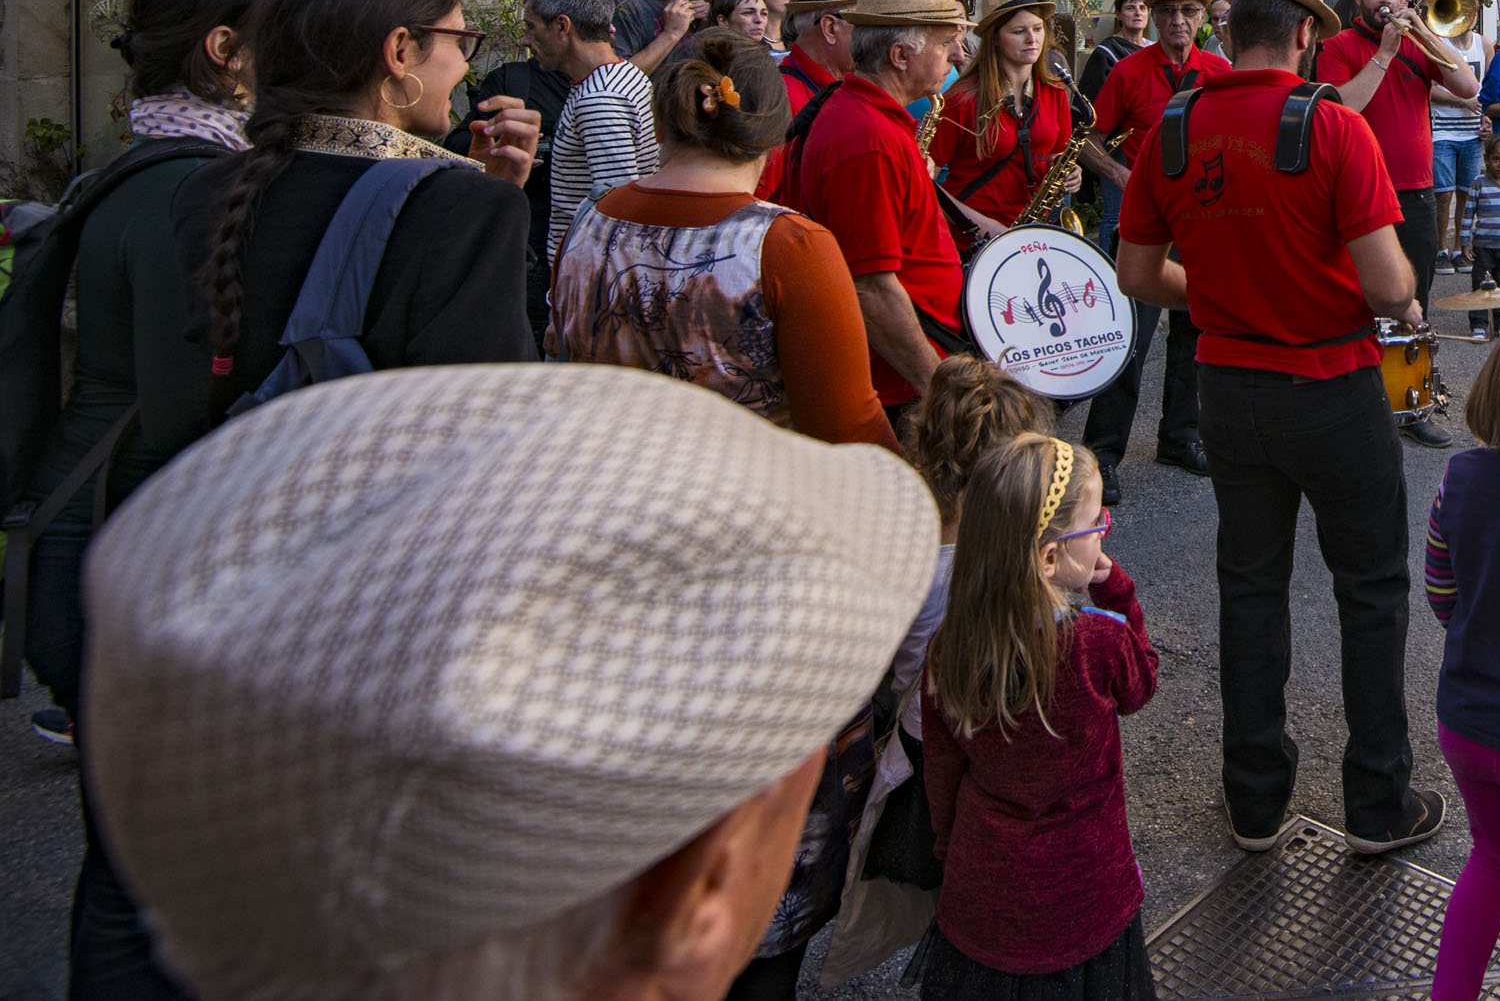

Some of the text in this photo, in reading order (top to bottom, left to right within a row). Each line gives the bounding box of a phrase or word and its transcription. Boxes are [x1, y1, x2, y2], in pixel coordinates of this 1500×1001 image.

[1020, 240, 1048, 254] PEÑA
[1005, 330, 1124, 364] LOS PICOS TACHOS
